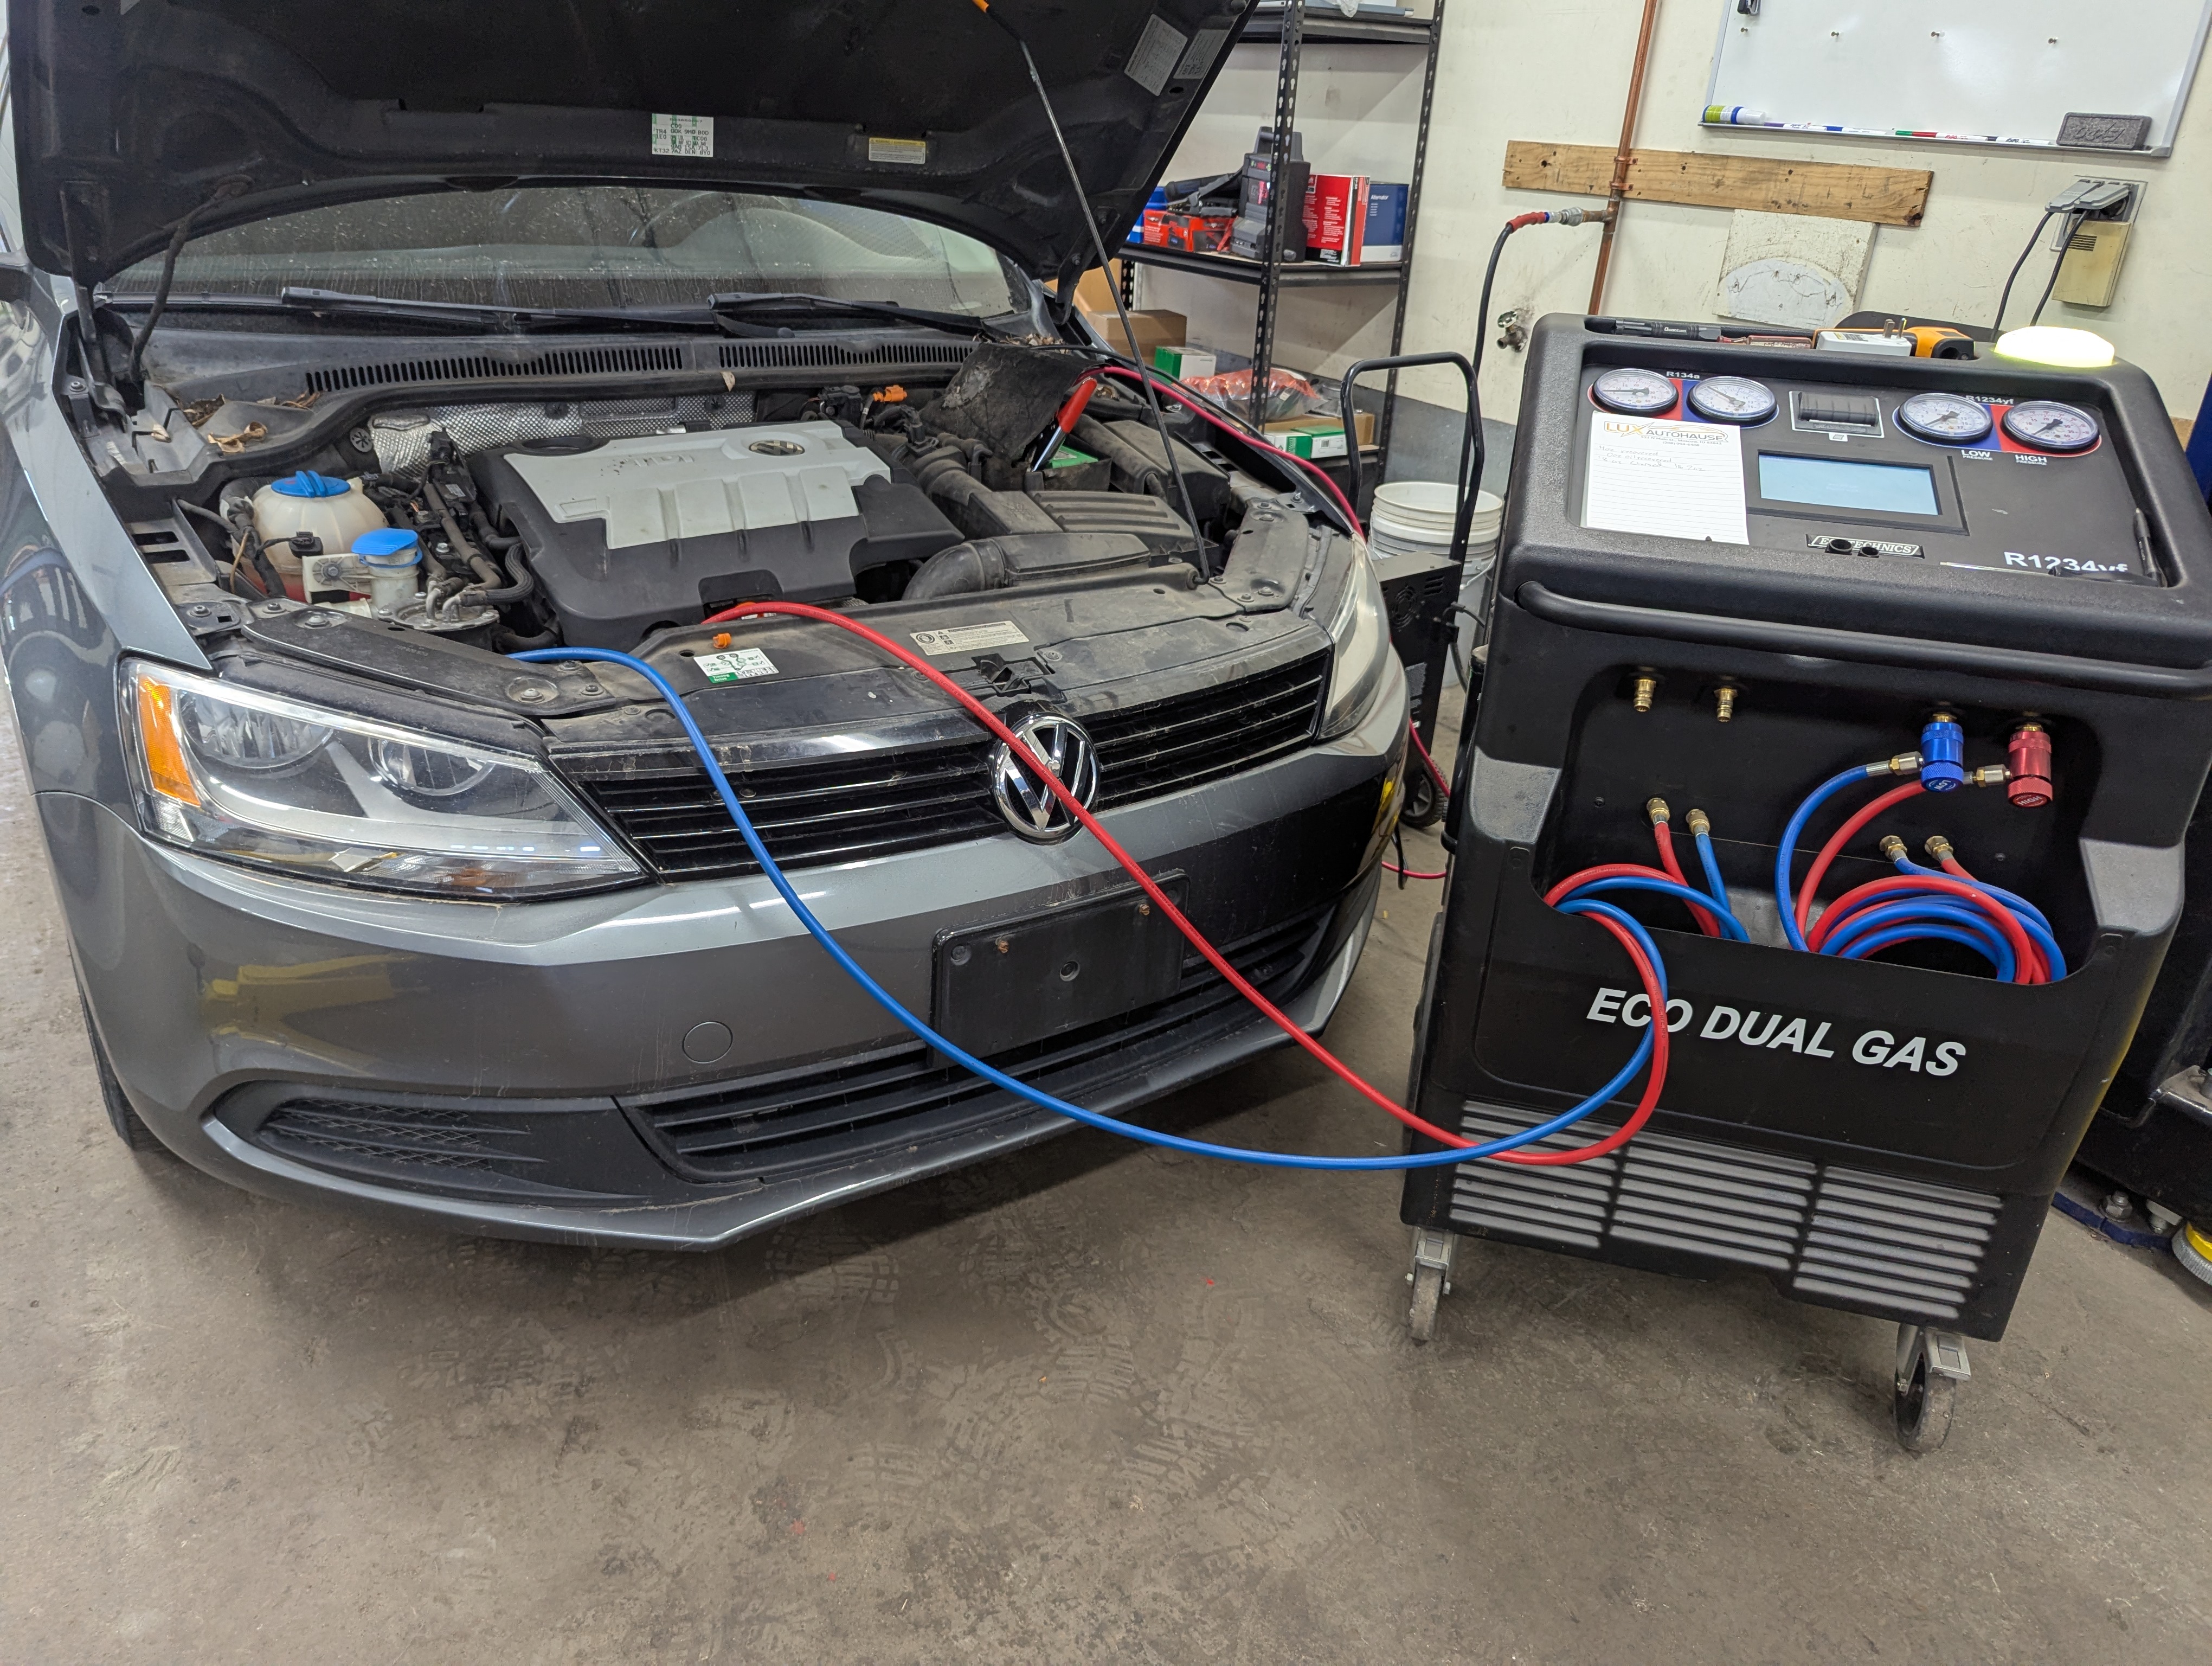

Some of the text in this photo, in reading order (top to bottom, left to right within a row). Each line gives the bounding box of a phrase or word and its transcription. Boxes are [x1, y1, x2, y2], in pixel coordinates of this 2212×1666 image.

[1666, 371, 1700, 379] R134a
[1965, 395, 2014, 405] R1234yf
[1606, 423, 1725, 441] LUX AUTOHAUSE
[1961, 450, 2048, 463] LOW HIGH
[1819, 537, 1912, 553] ETECHNICS
[1934, 779, 1952, 790] LOW
[2018, 796, 2041, 805] HIGH
[1586, 988, 1966, 1077] ECO DUAL GAS
